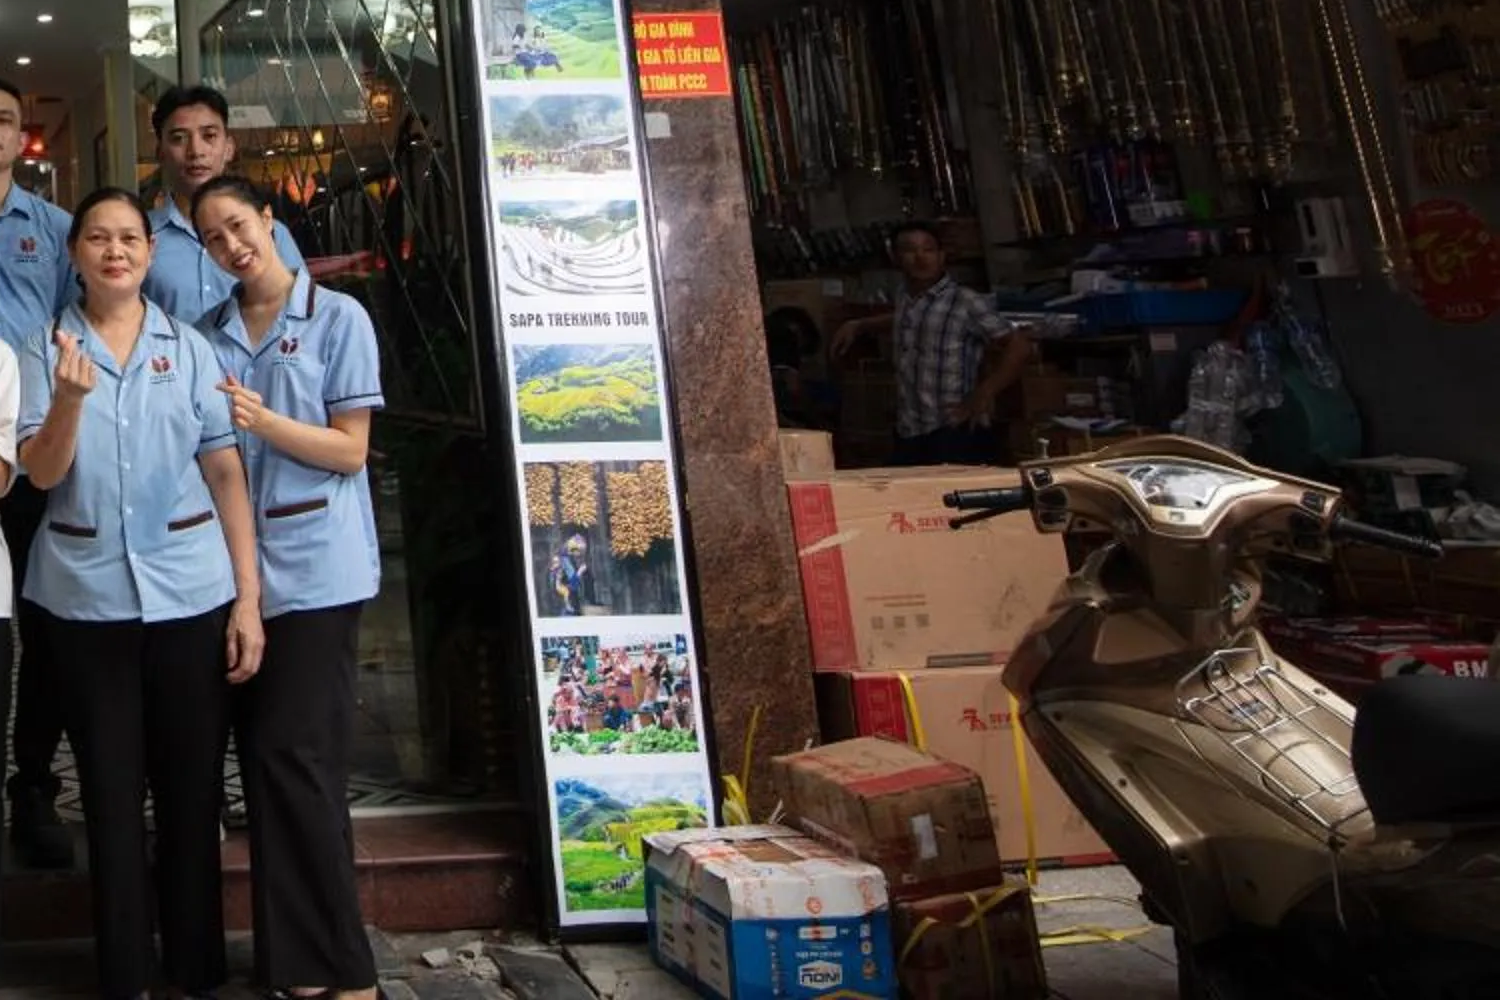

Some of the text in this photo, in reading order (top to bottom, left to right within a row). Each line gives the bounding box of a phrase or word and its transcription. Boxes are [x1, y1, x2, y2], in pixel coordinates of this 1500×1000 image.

[509, 311, 650, 328] SAPA TREKKING TOUR
